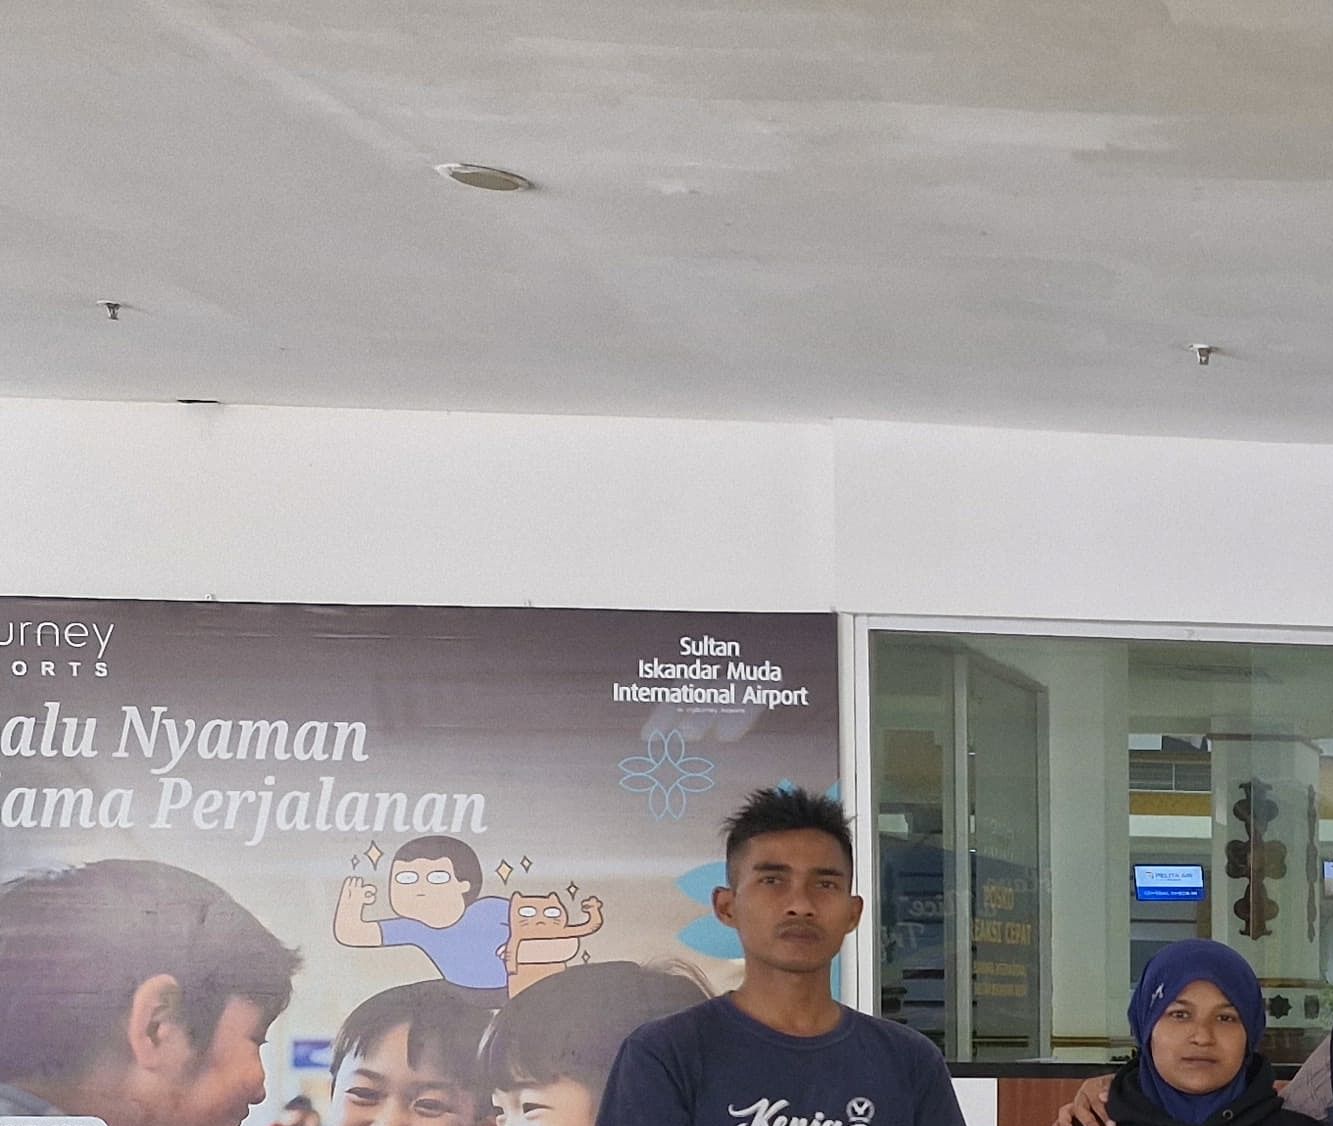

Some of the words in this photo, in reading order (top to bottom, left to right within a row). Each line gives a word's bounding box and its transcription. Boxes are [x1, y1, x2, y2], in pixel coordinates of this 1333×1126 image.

[680, 635, 741, 657] Sultan
[638, 657, 721, 680] Iskandar
[727, 660, 782, 682] Muda
[613, 682, 736, 705] International
[742, 685, 810, 710] Airport
[1, 702, 98, 758] alu
[111, 706, 370, 775] Nyaman
[1, 786, 135, 830] ama
[149, 776, 488, 847] Perjalanan
